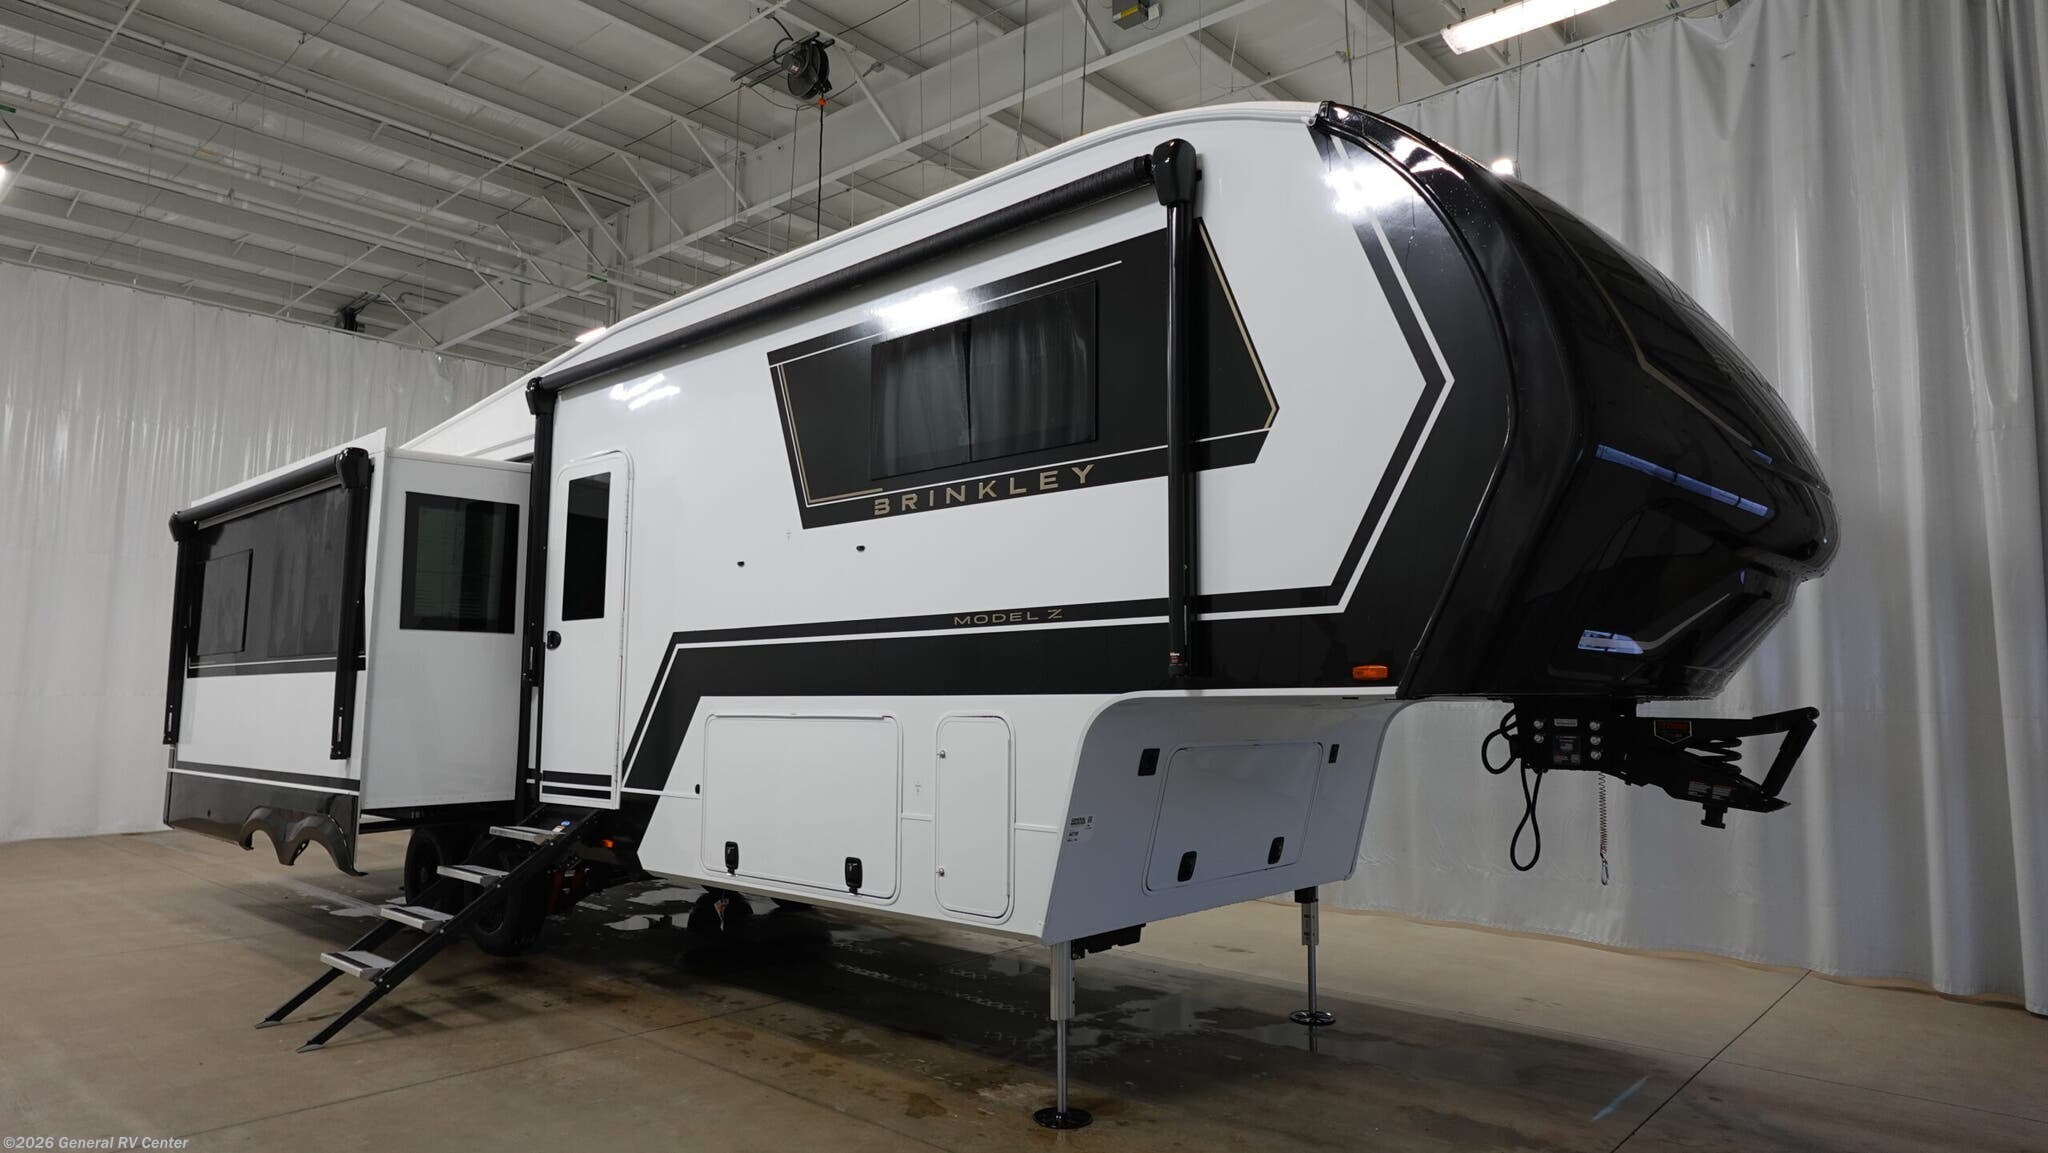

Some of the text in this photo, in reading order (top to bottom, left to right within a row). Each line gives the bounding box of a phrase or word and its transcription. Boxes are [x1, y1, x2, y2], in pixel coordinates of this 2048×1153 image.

[874, 464, 1094, 516] BRINKLEY
[954, 608, 1063, 625] MODEL Z
